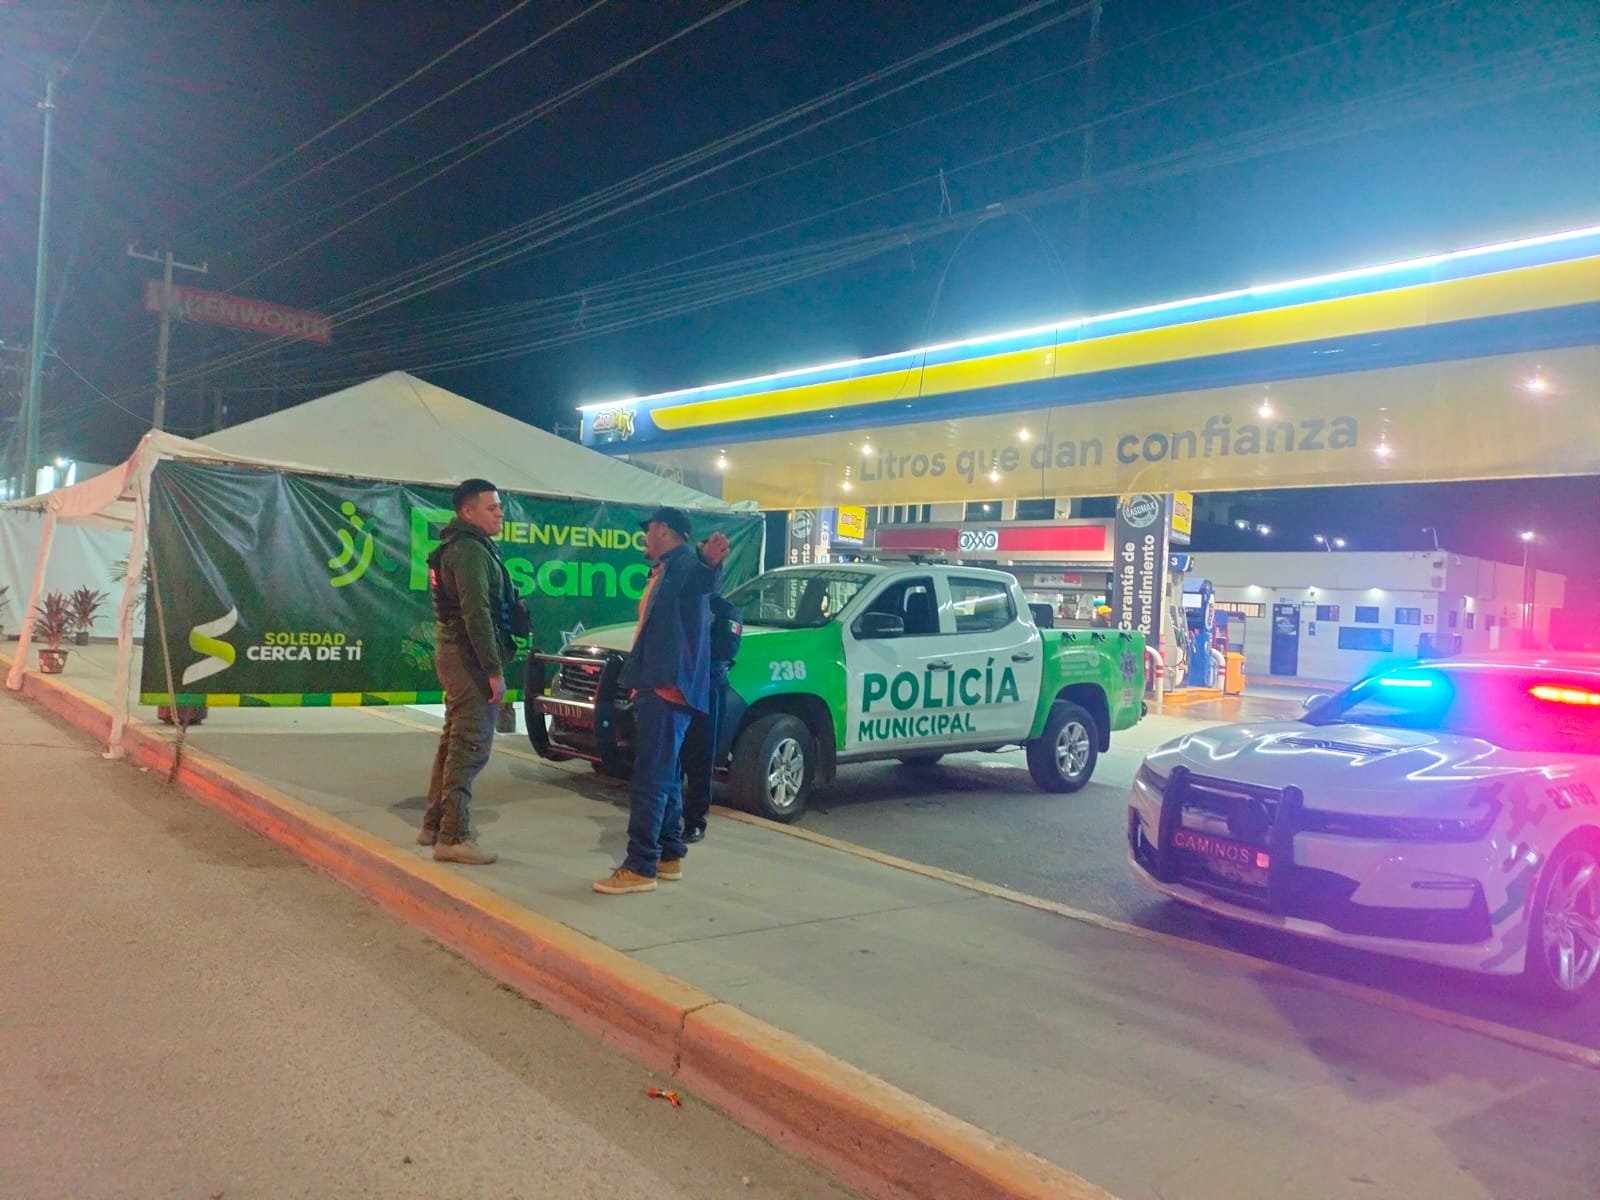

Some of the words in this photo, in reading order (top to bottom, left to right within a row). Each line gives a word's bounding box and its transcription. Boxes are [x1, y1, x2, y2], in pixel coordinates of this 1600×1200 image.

[860, 447, 946, 482] Litros
[956, 444, 1020, 484] que
[1031, 431, 1104, 470] dan
[1116, 414, 1360, 465] confianza
[959, 531, 998, 550] OXXO
[1121, 542, 1136, 562] de
[1170, 557, 1179, 566] 3
[1137, 534, 1155, 635] Rendimiento
[1119, 565, 1135, 632] Garantía
[265, 632, 346, 646] SOLEDAD
[246, 645, 312, 661] CERCA
[316, 646, 342, 661] DE
[769, 659, 807, 681] 238
[862, 656, 1020, 713] POLICÍA
[858, 712, 977, 742] MUNICIPAL
[1175, 832, 1250, 863] CAMINOS
